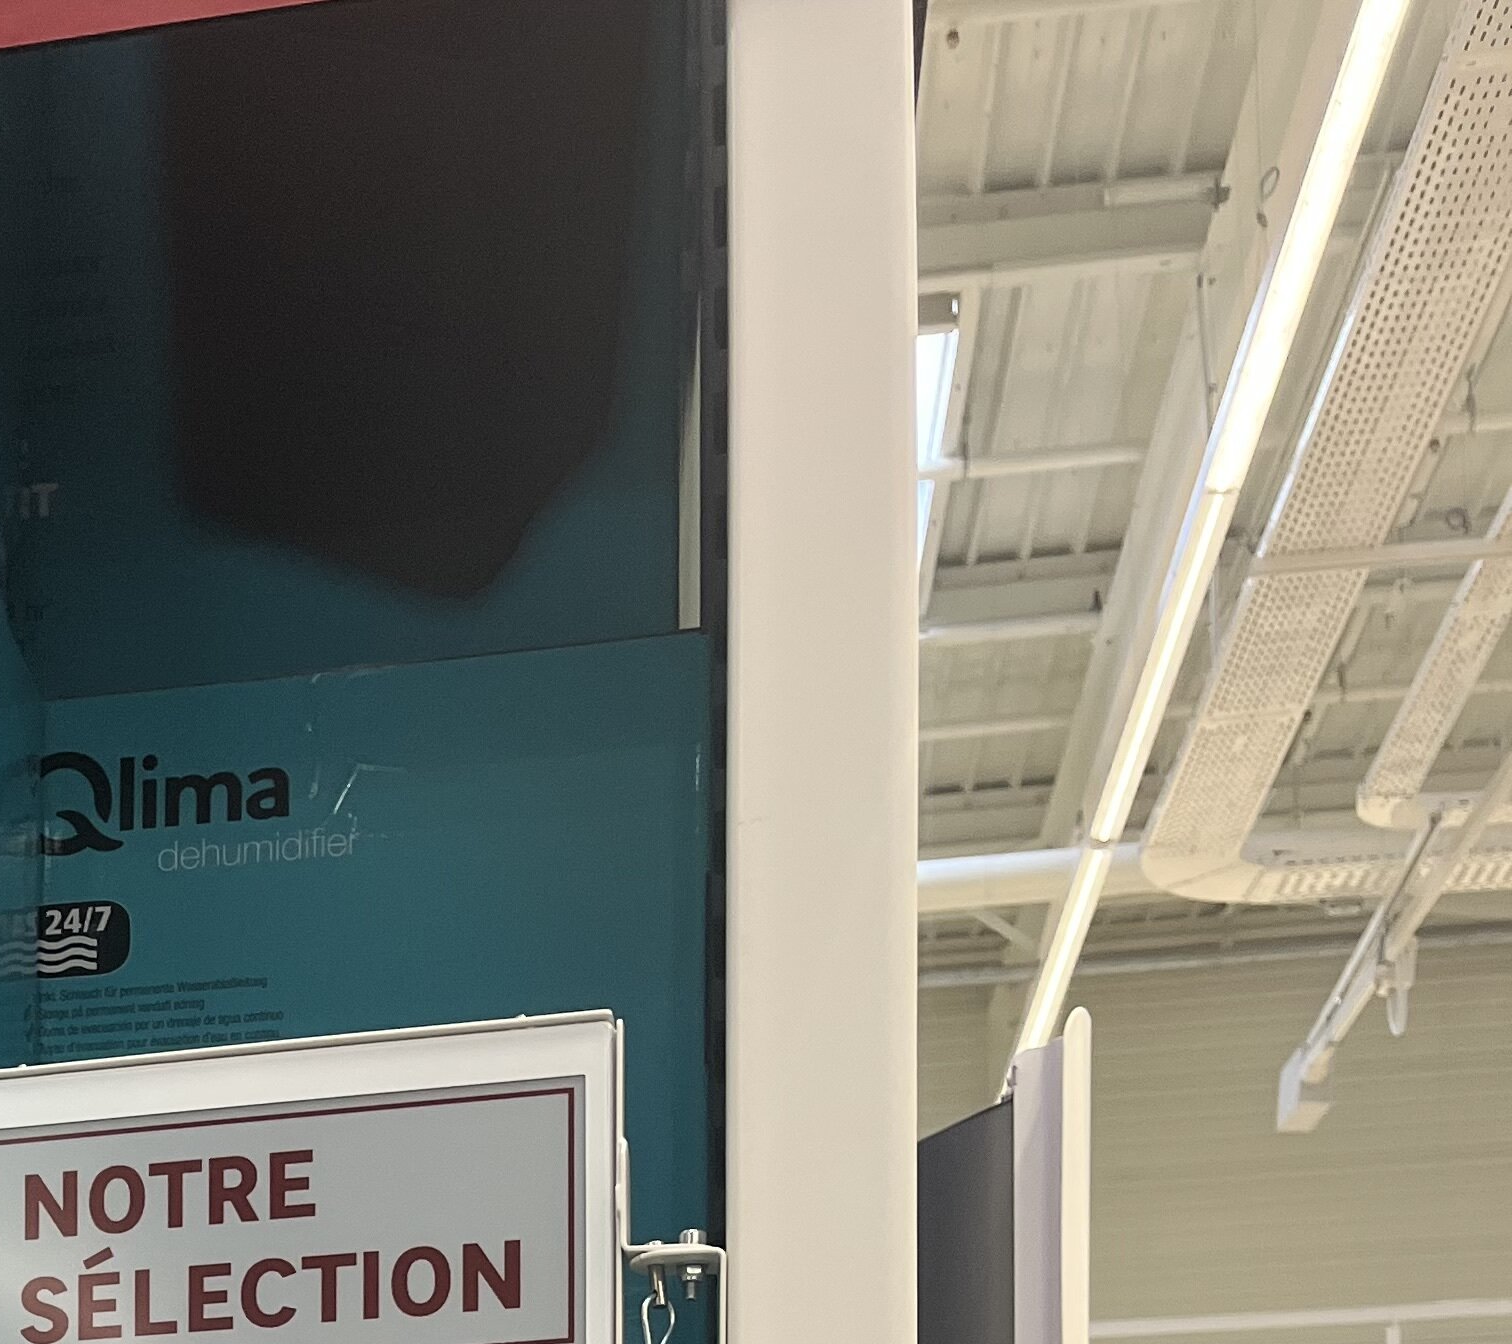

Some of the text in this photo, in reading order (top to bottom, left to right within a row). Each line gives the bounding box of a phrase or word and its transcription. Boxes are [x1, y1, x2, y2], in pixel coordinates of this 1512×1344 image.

[156, 830, 356, 874] dehumidifier
[45, 905, 112, 937] 24/7
[23, 1148, 317, 1241] NOTRE
